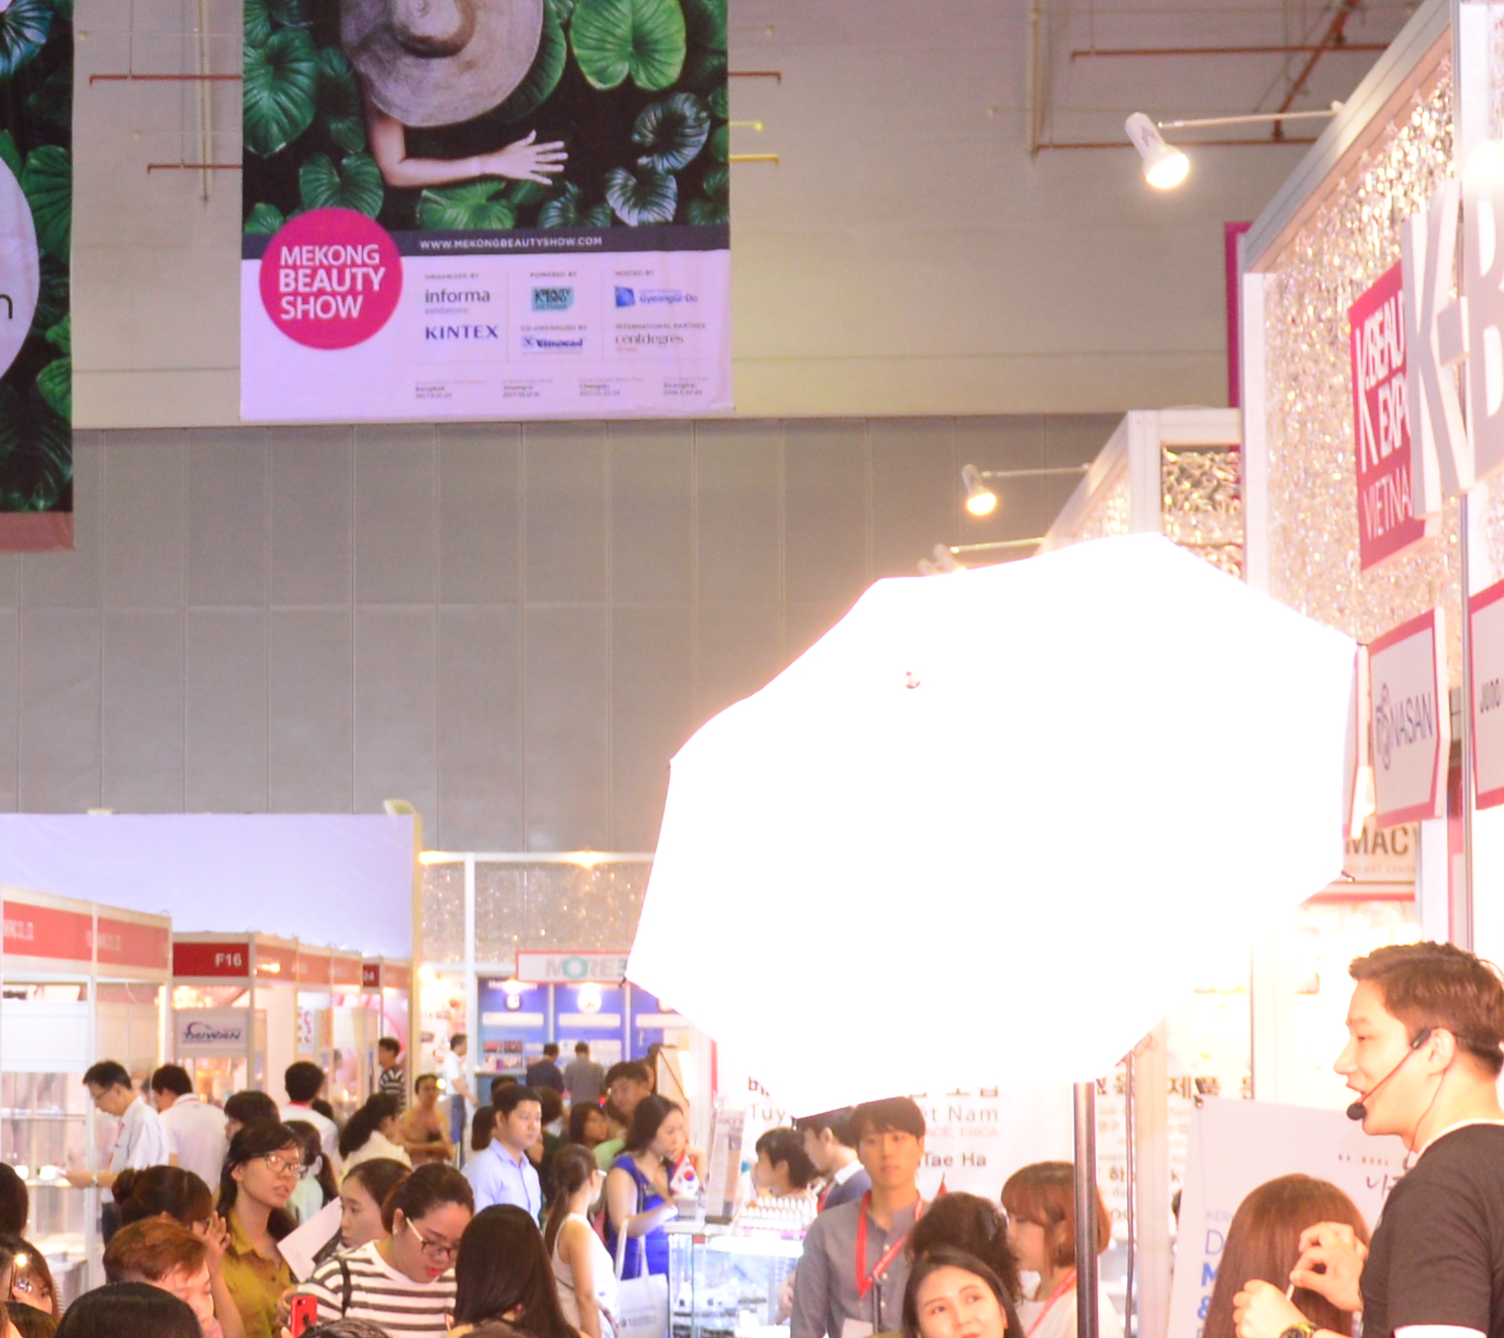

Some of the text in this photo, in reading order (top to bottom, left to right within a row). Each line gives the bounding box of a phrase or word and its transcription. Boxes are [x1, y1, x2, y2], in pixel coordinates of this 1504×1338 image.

[420, 237, 602, 249] WWW.MEKONGBEAUTYSHOW.COM
[280, 244, 380, 267] MEKONG
[279, 267, 385, 292] BEAUTY
[426, 289, 490, 303] informa
[280, 294, 363, 321] SHOW
[426, 325, 498, 340] KINTEX
[1391, 692, 1433, 749] NASAN
[215, 952, 242, 966] F16
[947, 1104, 999, 1122] Nam
[962, 1152, 987, 1167] Ha
